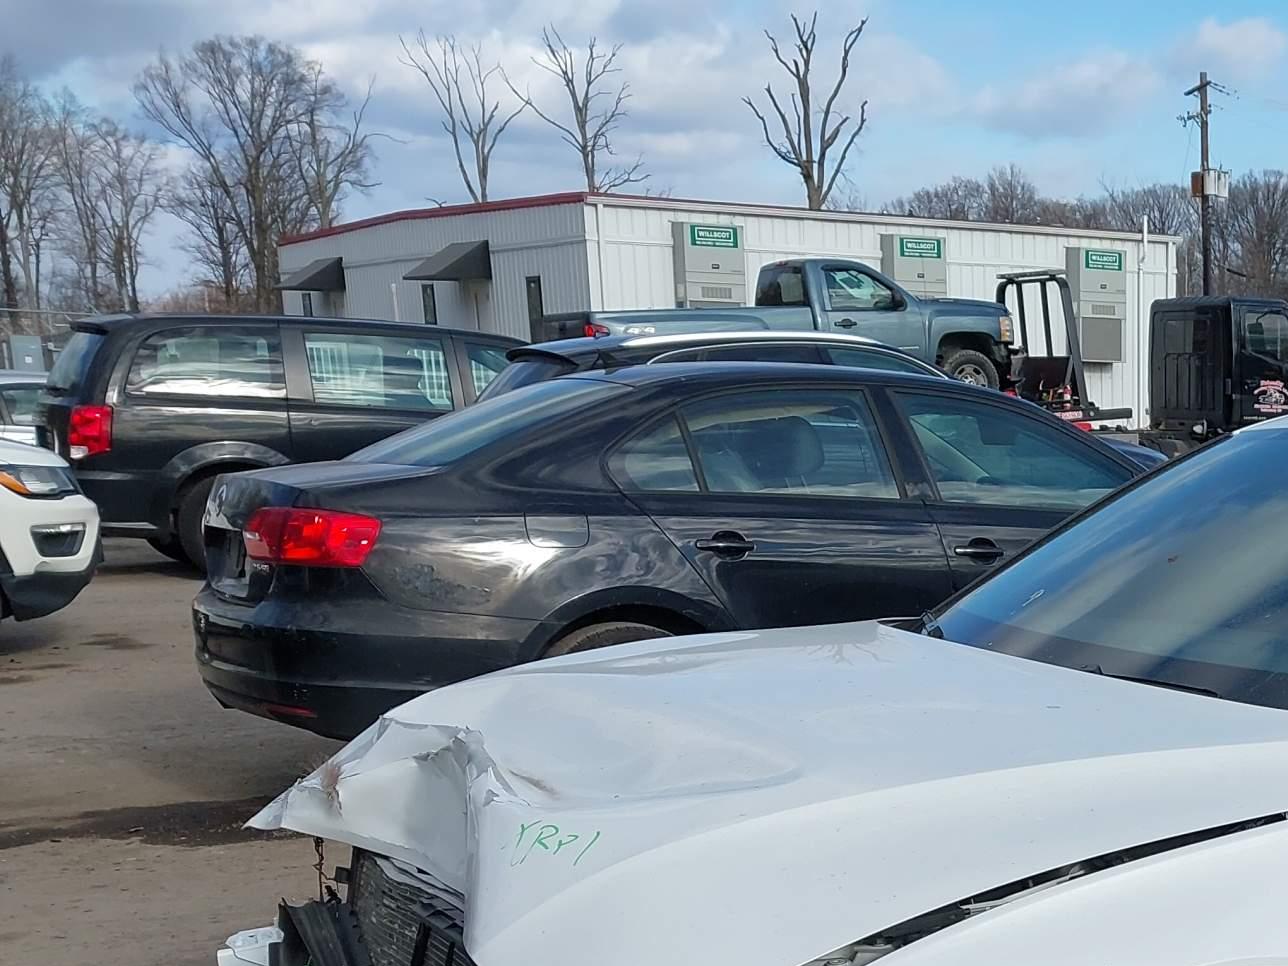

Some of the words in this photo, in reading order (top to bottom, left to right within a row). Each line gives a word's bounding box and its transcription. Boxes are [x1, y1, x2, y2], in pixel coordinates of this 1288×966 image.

[698, 230, 730, 239] WILLSCOT
[906, 242, 935, 250] WILLSCOT
[1091, 254, 1117, 263] WILLSCOT
